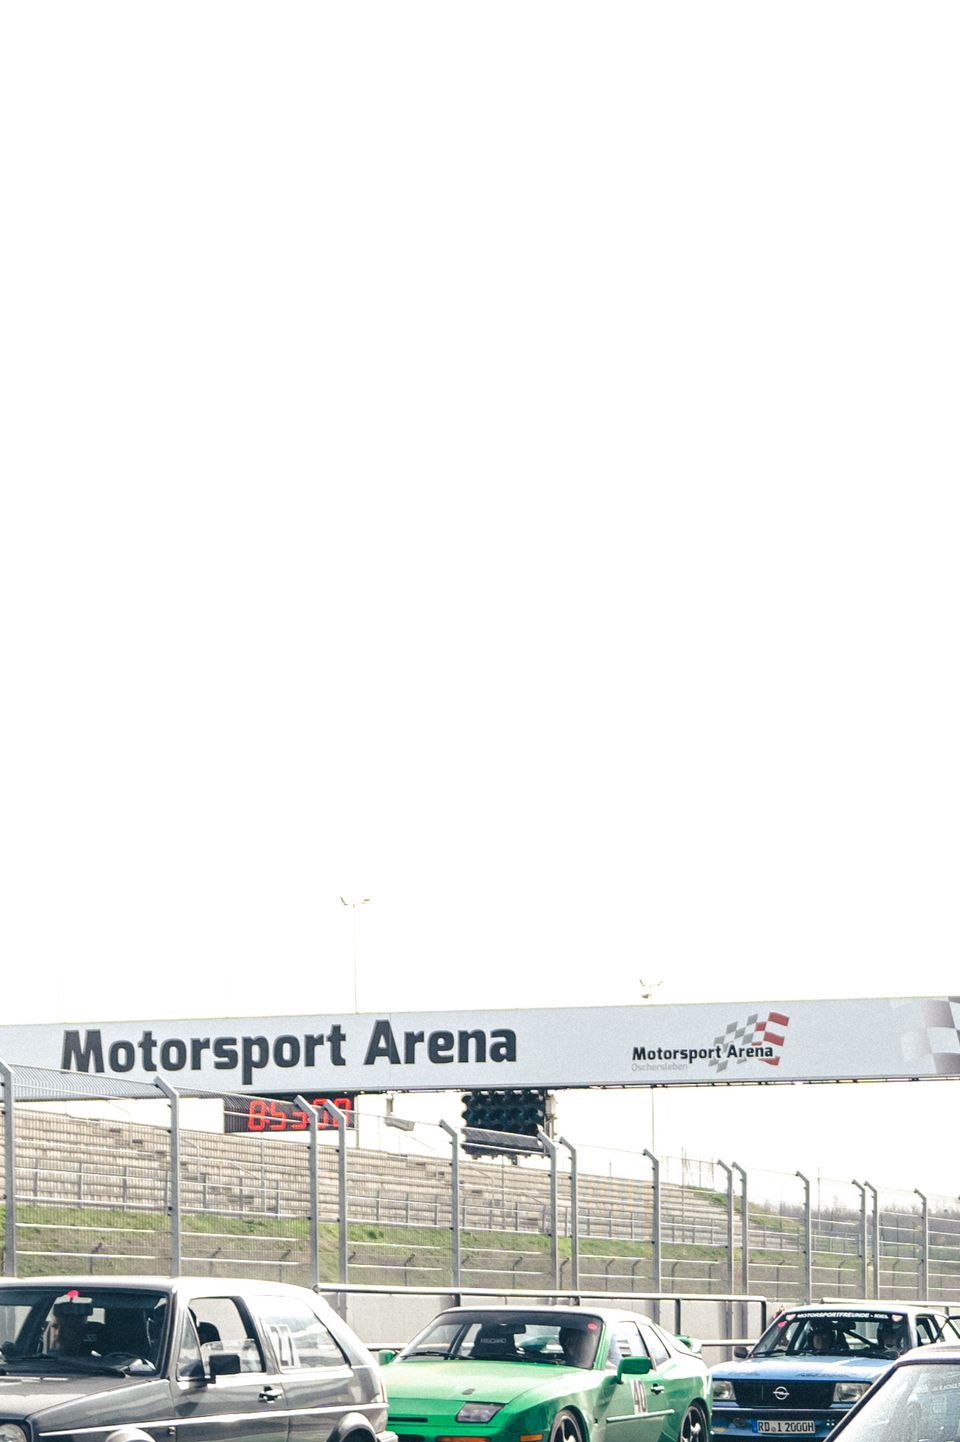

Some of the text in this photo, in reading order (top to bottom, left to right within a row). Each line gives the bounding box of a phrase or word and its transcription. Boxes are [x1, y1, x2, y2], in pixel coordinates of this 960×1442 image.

[60, 1019, 517, 1086] Motorsport Arena
[632, 1044, 773, 1064] Motorsport Arena
[631, 1062, 688, 1072] Oschersleben
